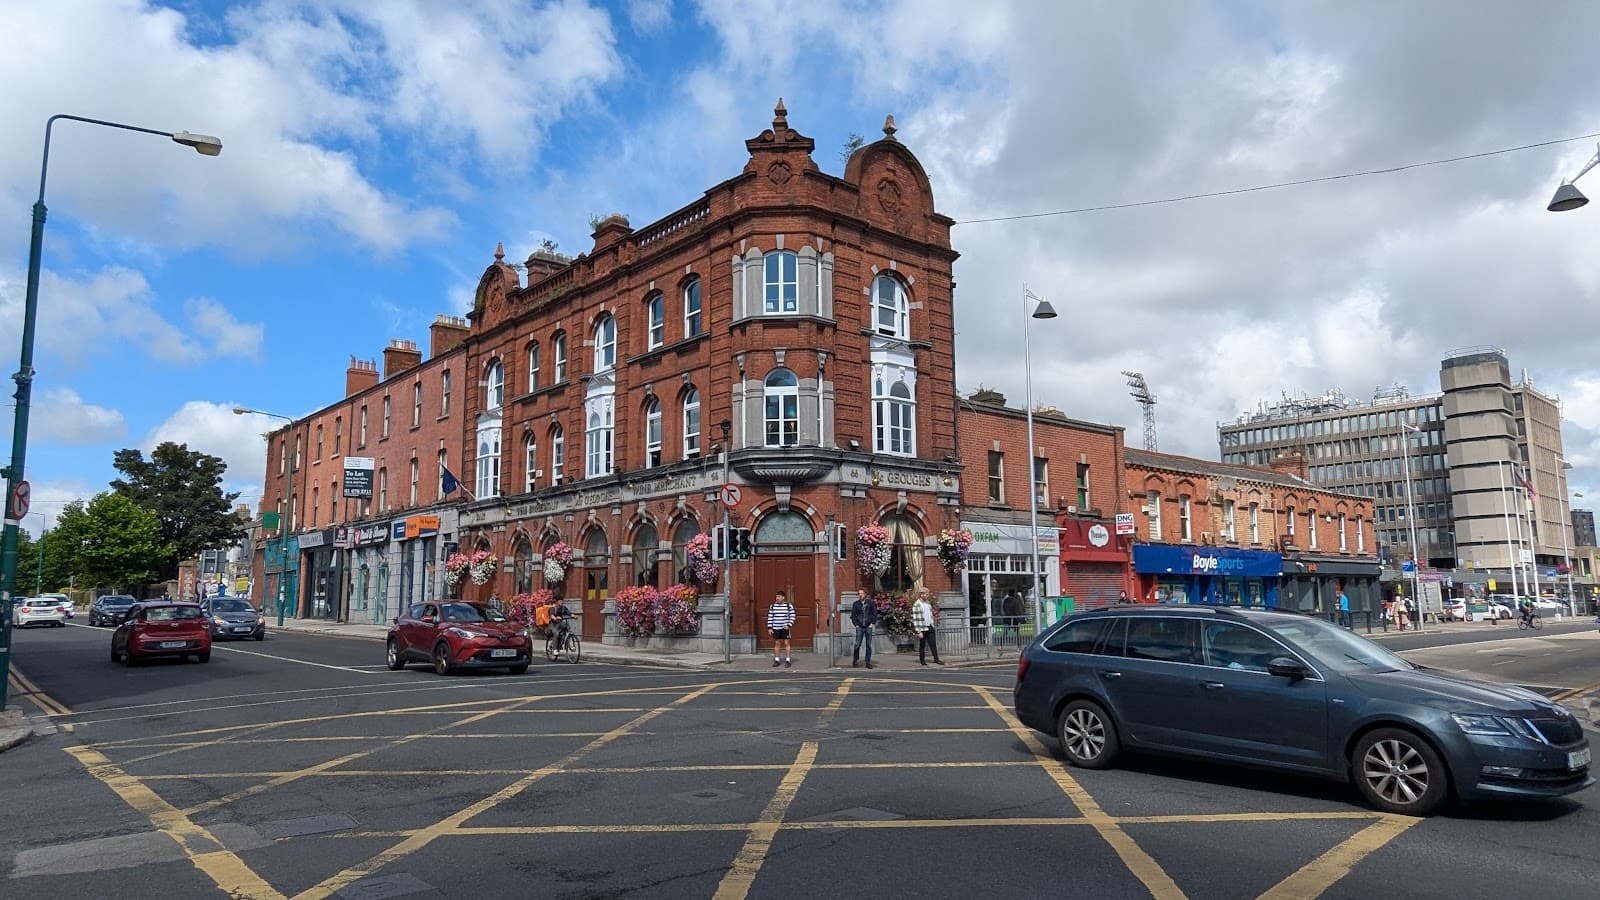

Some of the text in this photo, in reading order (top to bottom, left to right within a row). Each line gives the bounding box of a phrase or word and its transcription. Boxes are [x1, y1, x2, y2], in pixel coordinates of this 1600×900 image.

[850, 469, 859, 479] 66
[887, 471, 931, 487] GEOUGHS
[653, 475, 697, 492] MERCHANT
[974, 531, 999, 544] OXFAM
[1193, 554, 1244, 572] BoyleSports
